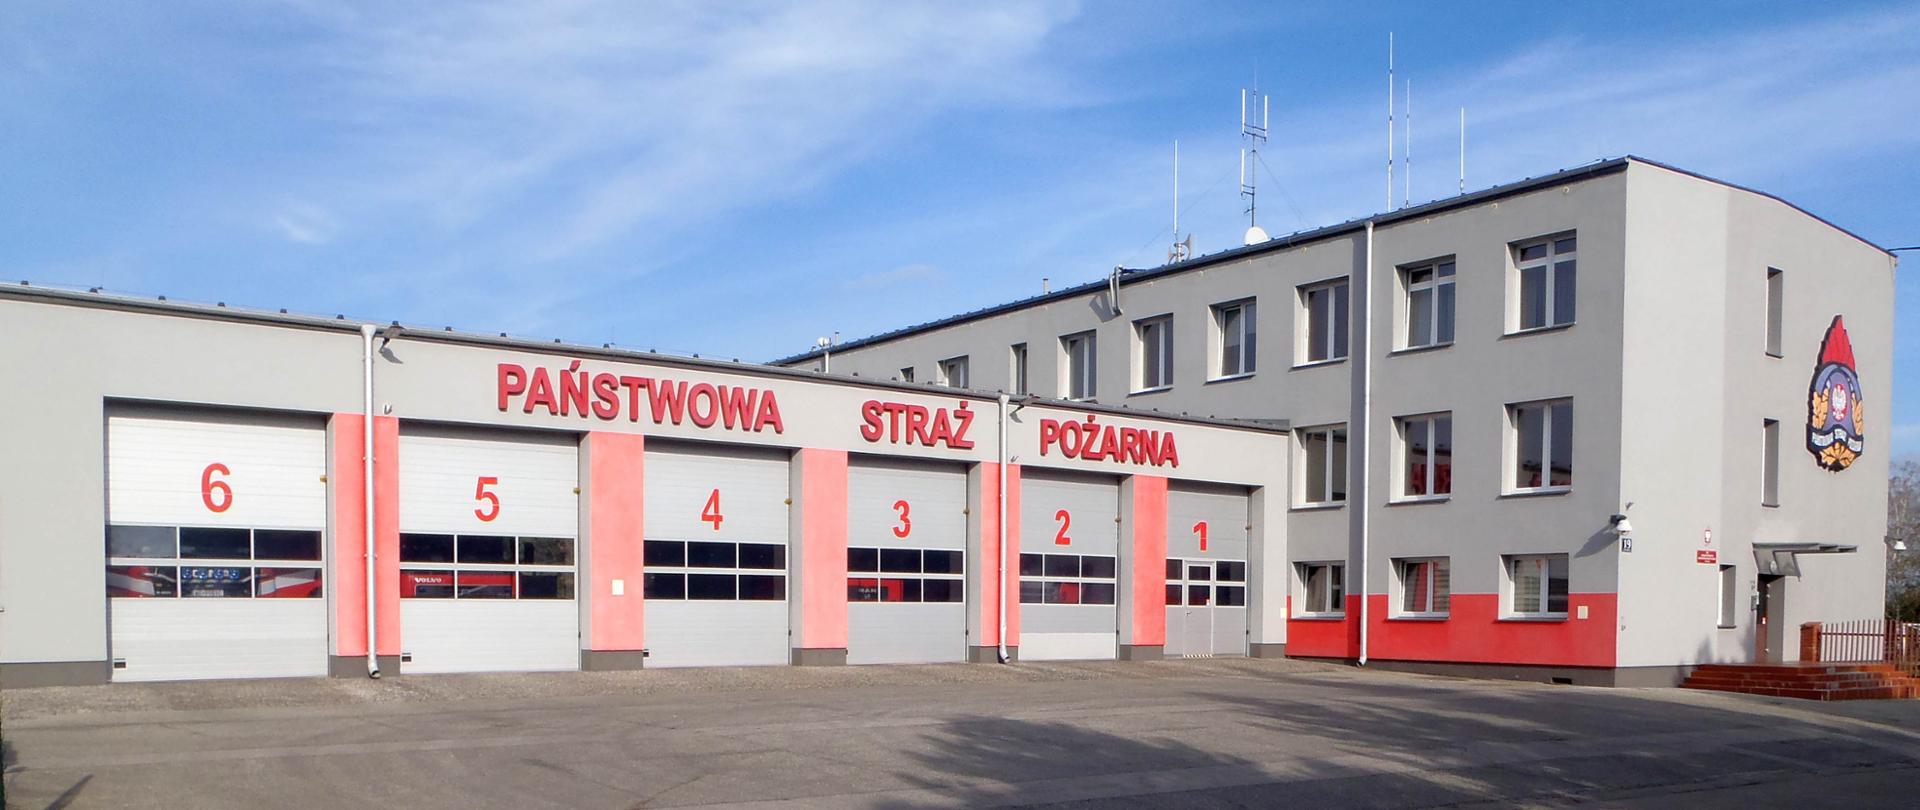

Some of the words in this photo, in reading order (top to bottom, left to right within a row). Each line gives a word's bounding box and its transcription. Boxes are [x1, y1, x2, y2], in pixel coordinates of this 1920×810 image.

[497, 360, 784, 434] PAŃSTWOWA
[860, 400, 976, 451] STRAŻ
[1040, 415, 1179, 468] POŻARNA
[201, 463, 233, 513] 6
[474, 476, 500, 522] 5
[700, 488, 724, 530] 4
[892, 499, 912, 539] 3
[1055, 508, 1072, 546] 2
[1193, 521, 1208, 552] 1
[1623, 539, 1631, 549] 19
